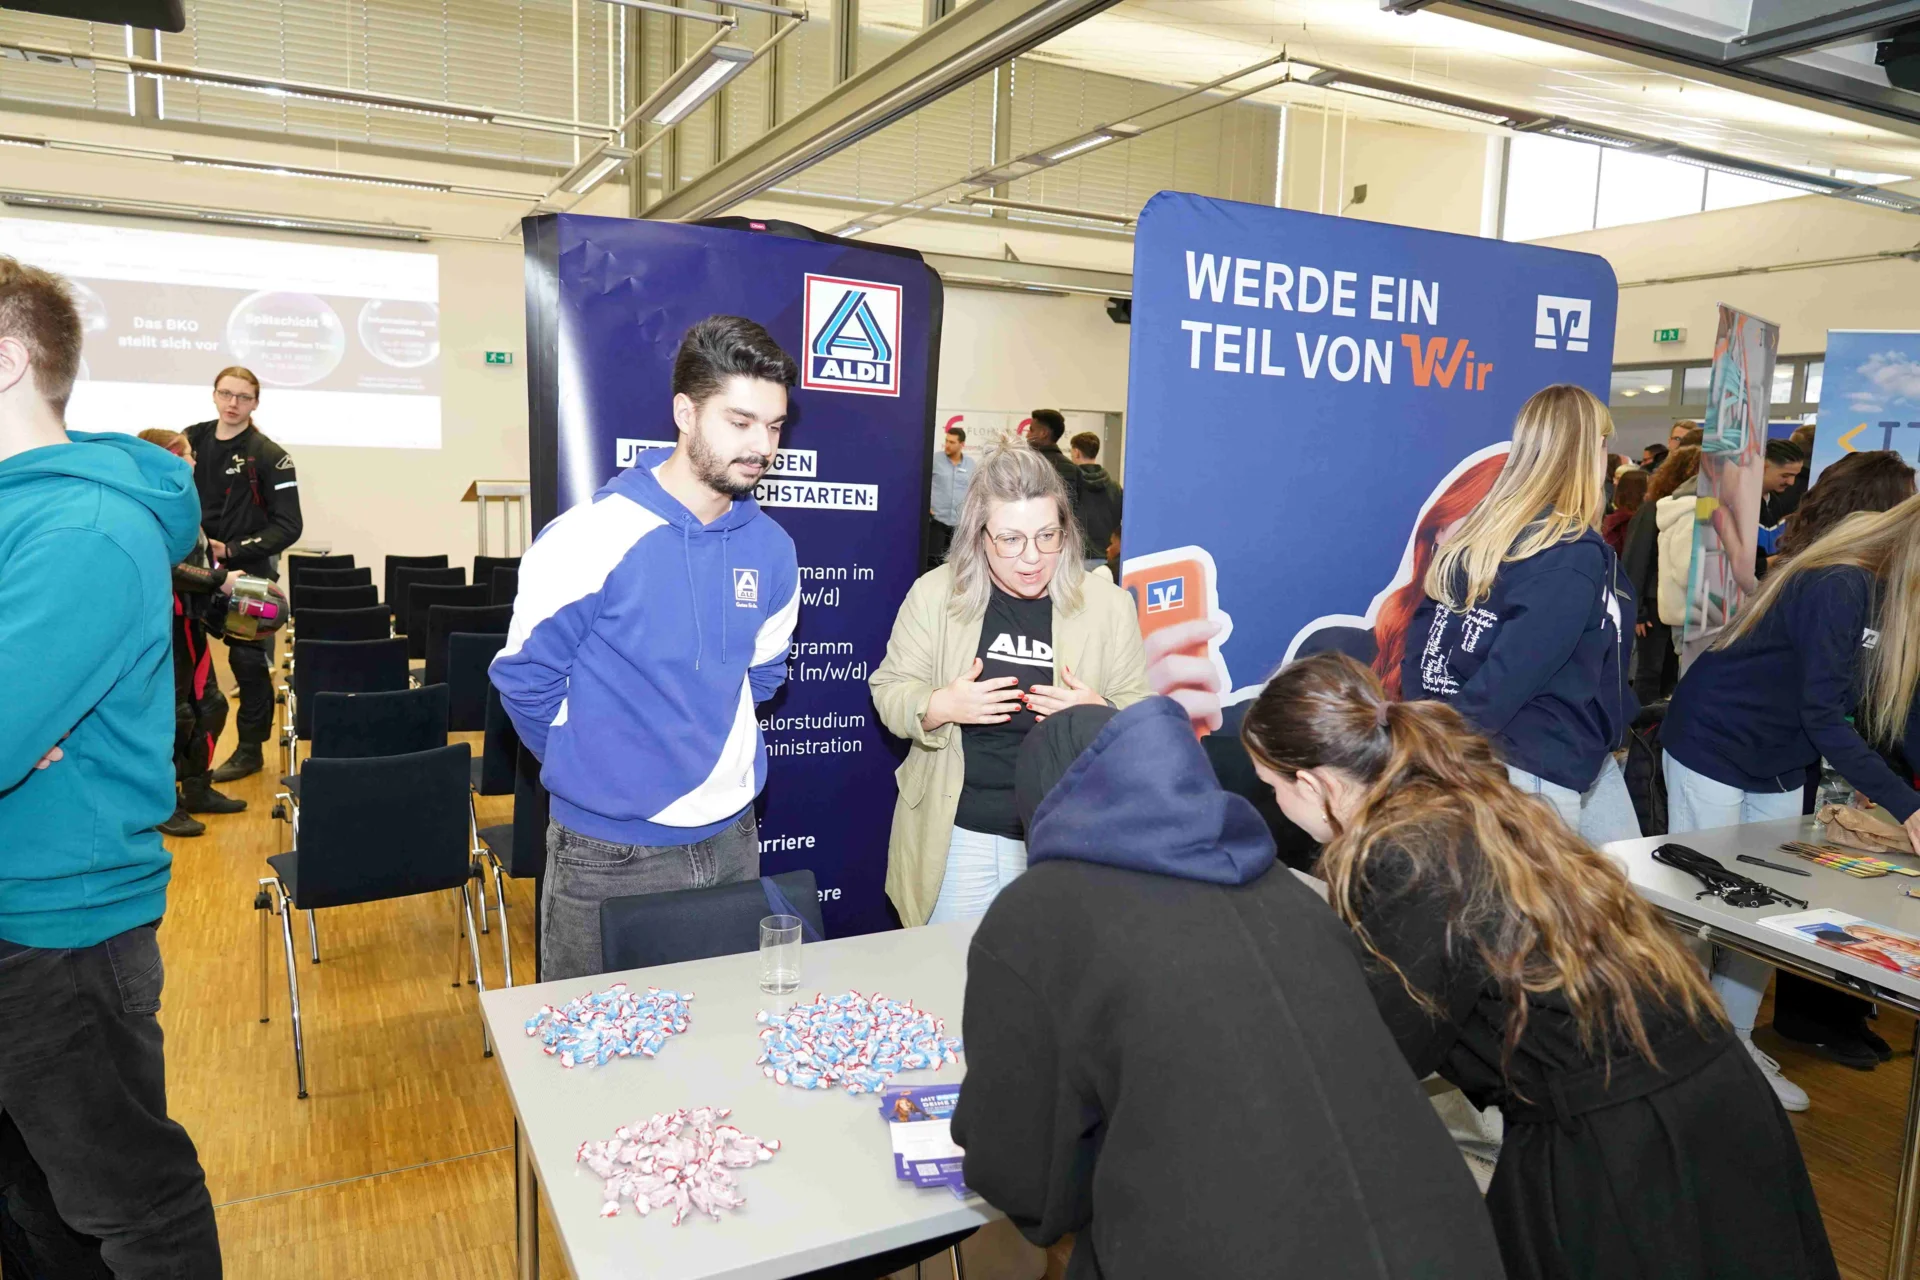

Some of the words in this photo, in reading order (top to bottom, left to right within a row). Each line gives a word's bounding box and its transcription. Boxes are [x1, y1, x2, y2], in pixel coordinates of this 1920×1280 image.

[1186, 250, 1357, 317] WERDE
[1370, 274, 1439, 326] EIN
[133, 316, 162, 330] Das
[166, 318, 199, 332] BKO
[118, 334, 157, 348] stellt
[160, 336, 192, 350] sich
[195, 340, 220, 351] vor
[1181, 320, 1285, 376] TEIL
[1296, 332, 1393, 384] VON
[1401, 333, 1493, 391] Wir
[820, 359, 884, 382] ALDI
[773, 453, 812, 472] GEN
[753, 484, 873, 506] CHSTARTEN:
[799, 567, 847, 580] mann
[853, 563, 874, 580] im
[799, 587, 840, 607] w/d)
[790, 641, 853, 659] gramm
[988, 633, 1053, 660] ALD
[787, 666, 795, 681] t
[800, 661, 868, 682] (m/w/d)
[759, 711, 865, 731] elorstudium
[765, 737, 862, 756] inistration
[758, 834, 816, 853] rriere
[817, 887, 842, 902] ere
